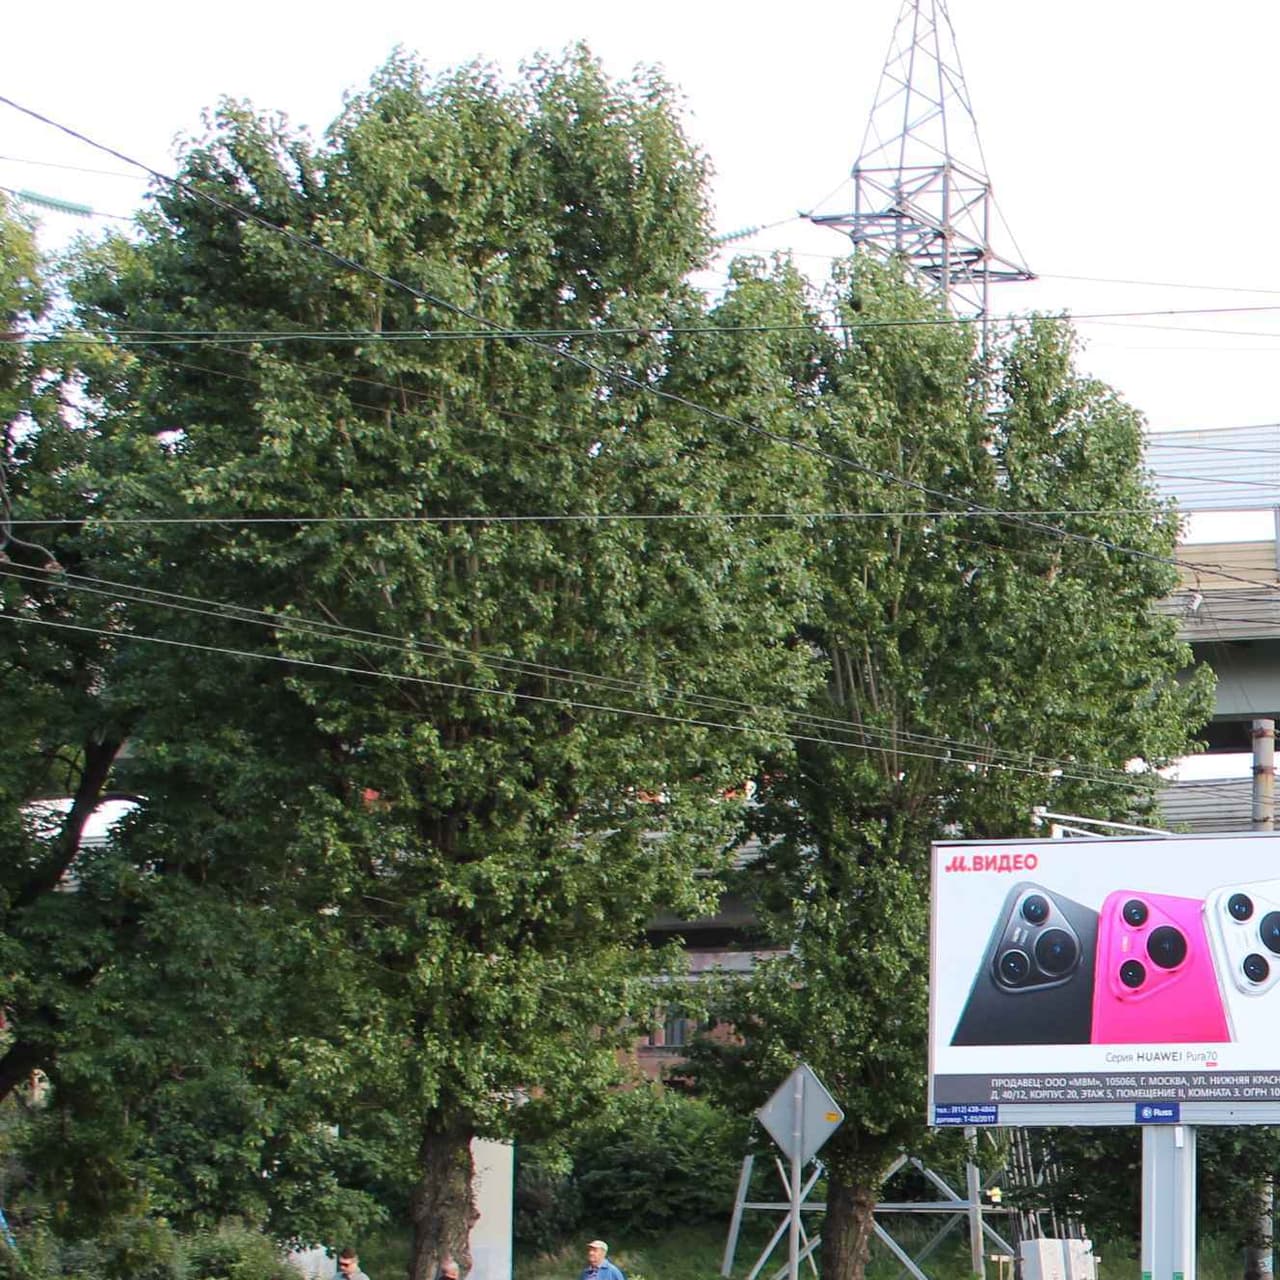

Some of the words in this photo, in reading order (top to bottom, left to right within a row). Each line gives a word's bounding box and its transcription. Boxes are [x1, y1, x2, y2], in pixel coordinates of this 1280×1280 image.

[945, 853, 1038, 873] М.ВИДЕО
[1105, 1052, 1134, 1064] Серия
[1136, 1051, 1183, 1062] HUAWEI
[991, 1078, 1043, 1088] ПРОДАВЕЦ:
[1044, 1078, 1067, 1087] ООО
[1069, 1077, 1102, 1087] «МВМ»,
[1105, 1077, 1138, 1086] 105066,
[1148, 1076, 1190, 1086] МОСКВА,
[1192, 1076, 1207, 1085] УЛ.
[1210, 1076, 1250, 1085] НИЖНЯЯ
[1030, 1090, 1065, 1099] КОРПУС
[1066, 1090, 1079, 1099] 20,
[1080, 1090, 1104, 1098] ЭТАЖ
[1106, 1089, 1114, 1099] 5,
[1116, 1089, 1177, 1098] ПОМЕЩЕНИЕ
[1188, 1088, 1232, 1097] КОМНАТА
[1243, 1088, 1268, 1097] ОГРН
[1153, 1108, 1173, 1117] Russ
